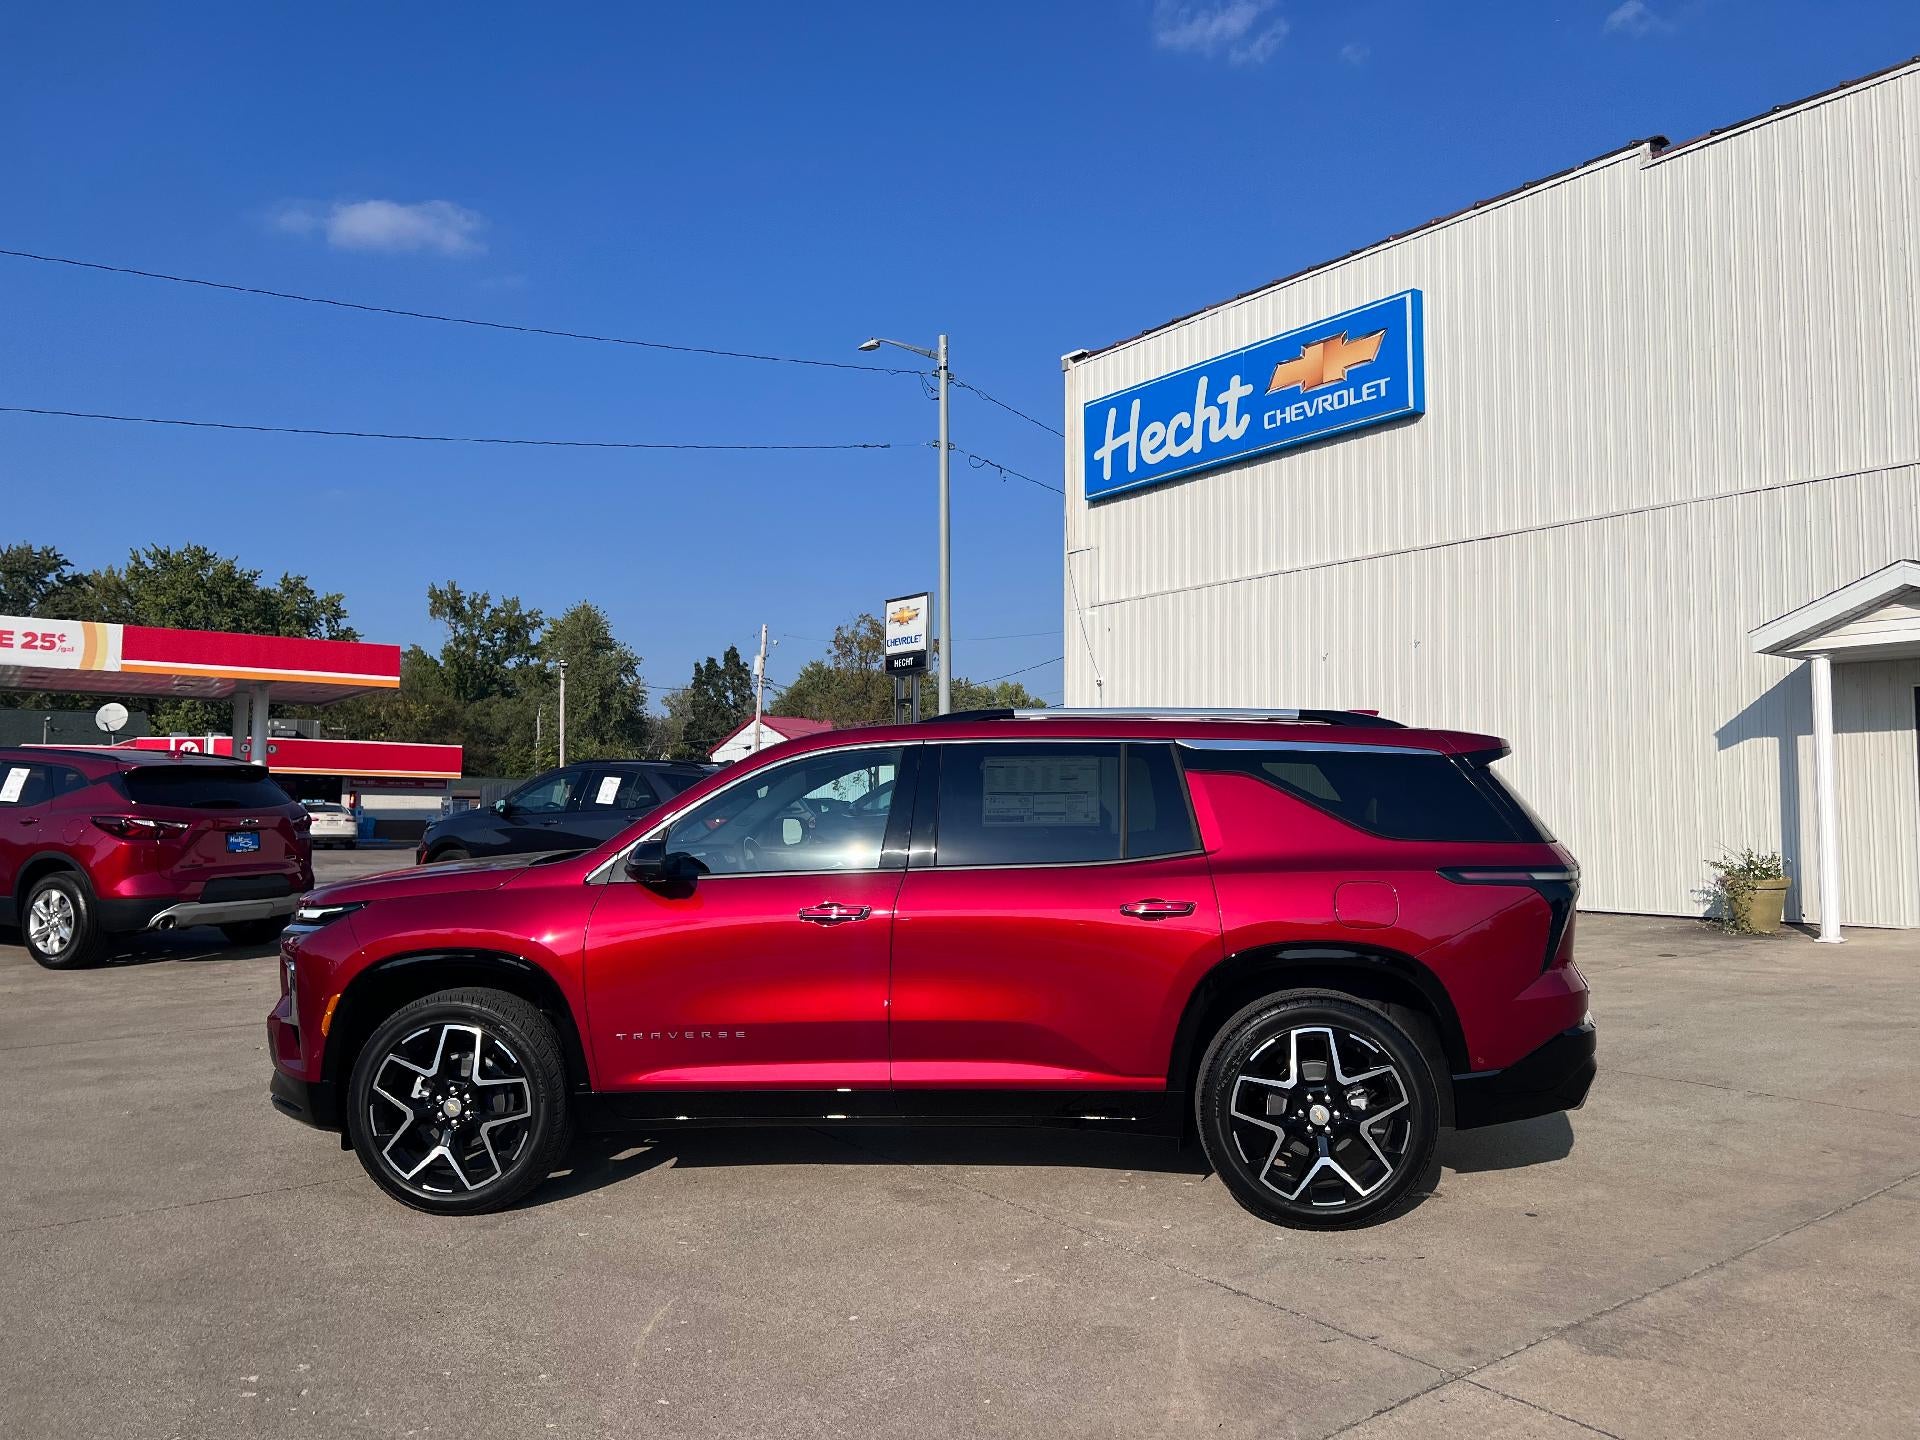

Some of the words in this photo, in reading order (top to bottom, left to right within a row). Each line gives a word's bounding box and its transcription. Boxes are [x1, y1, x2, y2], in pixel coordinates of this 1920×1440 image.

[1264, 377, 1390, 430] CHEVROLET
[1094, 375, 1253, 480] Hecht
[886, 634, 922, 647] CHEVROLET
[894, 657, 914, 668] HECHT
[616, 1031, 747, 1040] TRAVERSE
